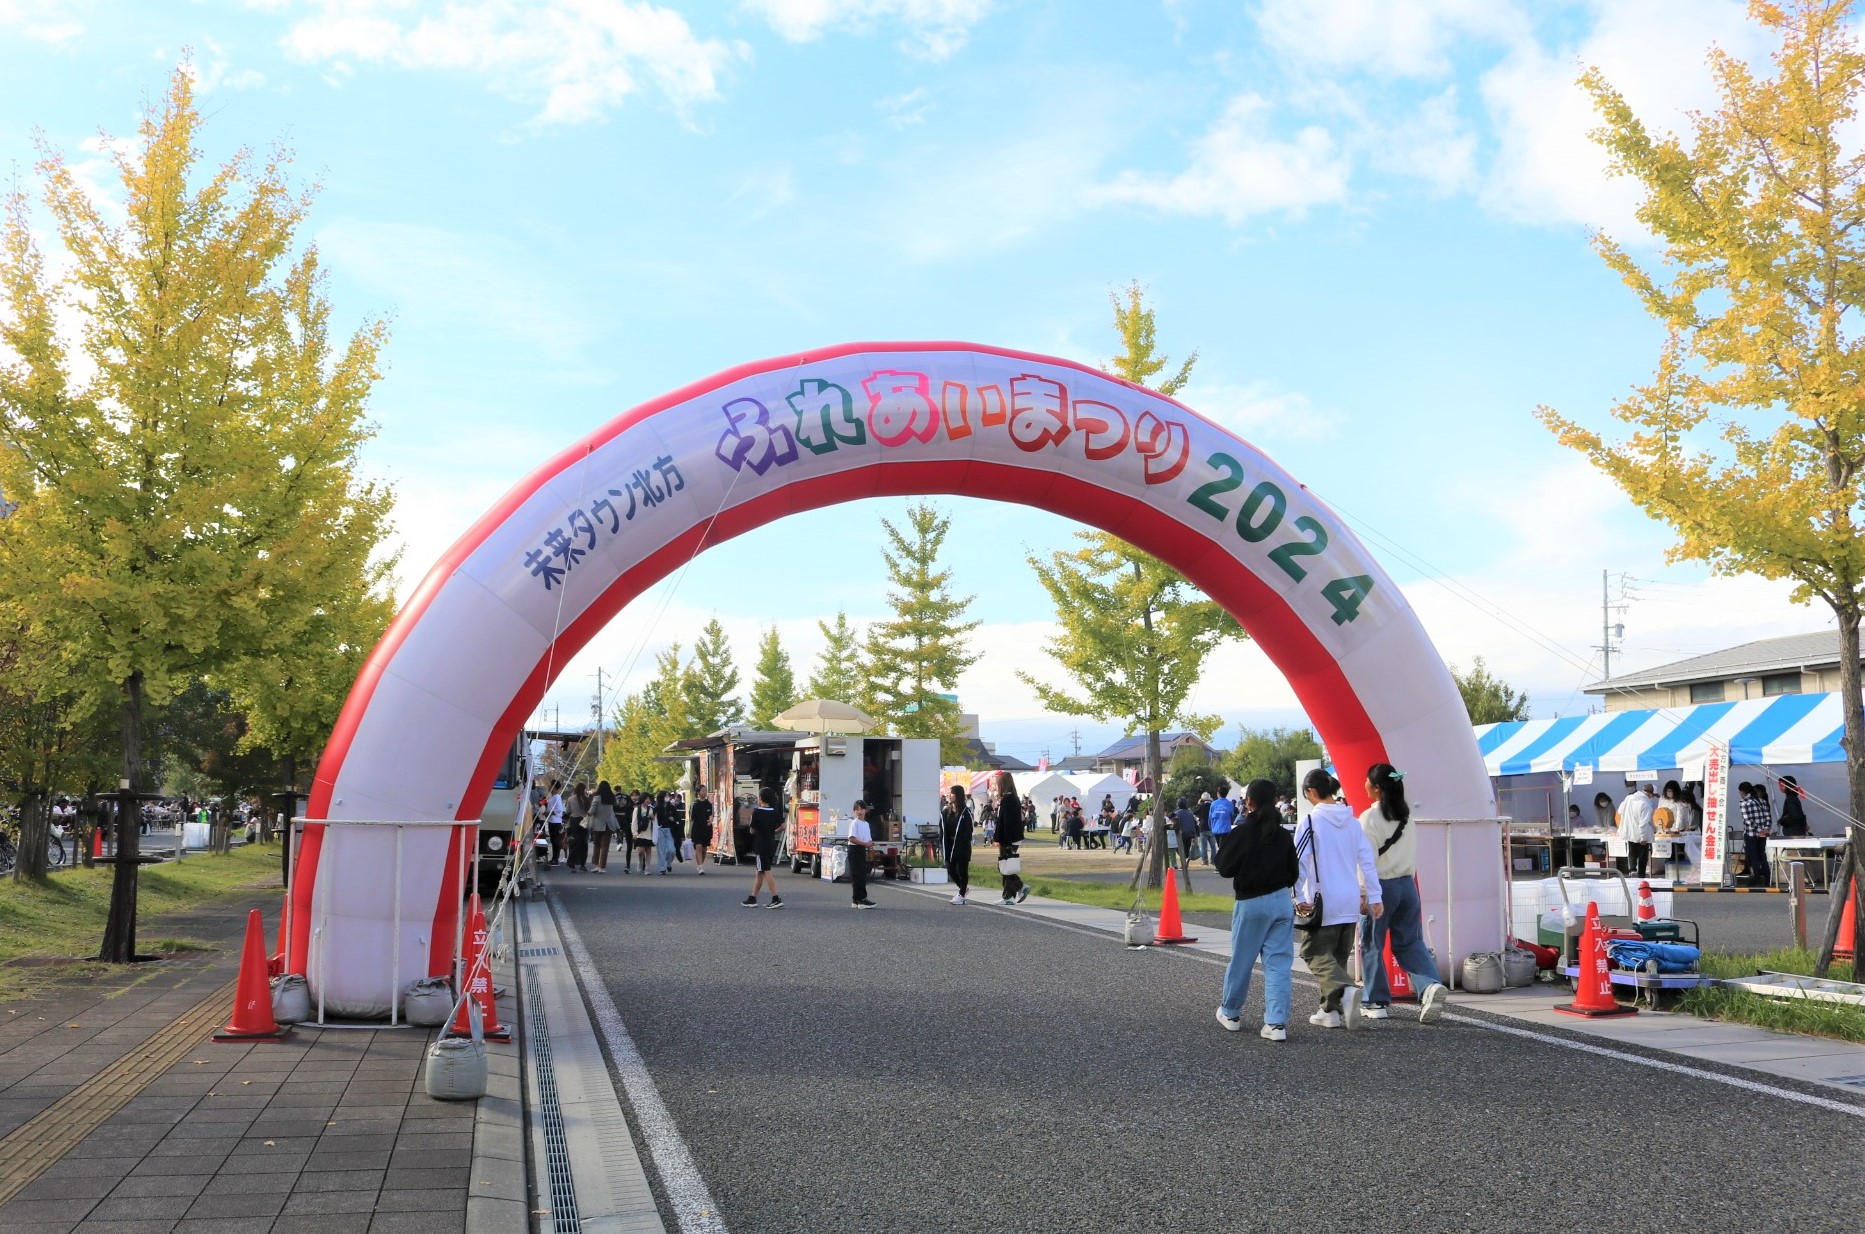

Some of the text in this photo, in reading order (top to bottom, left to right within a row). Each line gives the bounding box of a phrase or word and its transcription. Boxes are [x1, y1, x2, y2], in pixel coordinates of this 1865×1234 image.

[523, 369, 1374, 627] 未来タウン北方 ふれあいまつり 2024
[1704, 745, 1720, 860] 大売出し抽せん会場
[1590, 916, 1612, 995] 立入禁止
